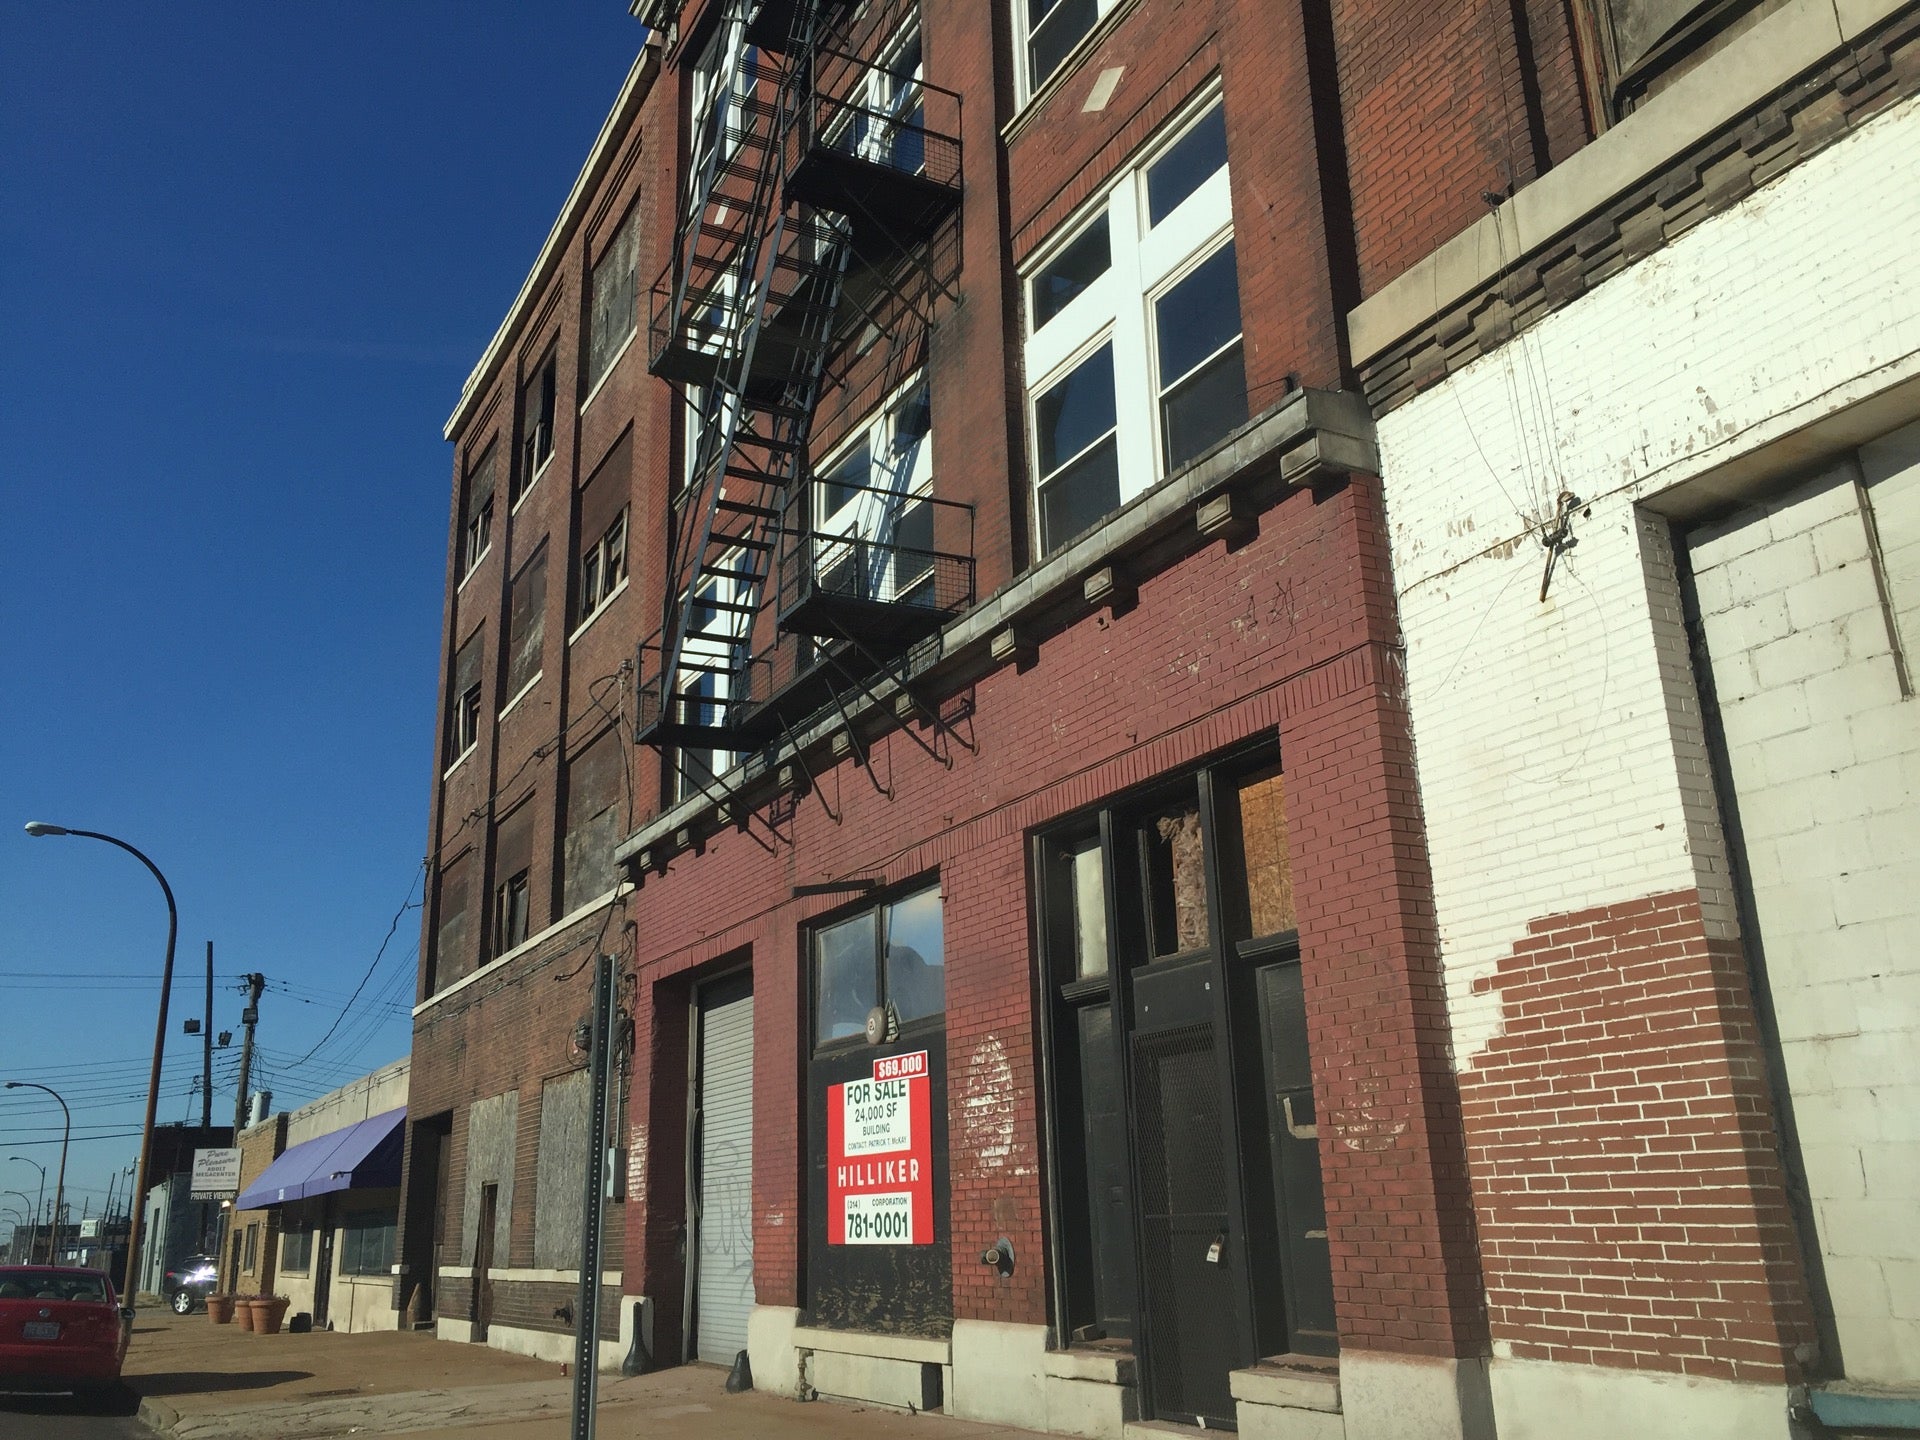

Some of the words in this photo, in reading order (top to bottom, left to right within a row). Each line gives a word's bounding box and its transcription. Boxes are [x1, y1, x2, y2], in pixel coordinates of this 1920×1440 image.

[879, 1055, 922, 1077] $69,000
[847, 1085, 870, 1106] FOR
[875, 1079, 906, 1101] SALE
[855, 1105, 884, 1124] 24,000
[887, 1102, 897, 1118] SF
[862, 1123, 890, 1136] BUILDING
[869, 1138, 885, 1148] PATRICK
[207, 1150, 228, 1158] Pure
[198, 1157, 236, 1167] Pleasure
[838, 1158, 919, 1187] HILLIKER
[190, 1192, 212, 1200] PRIVATE
[213, 1191, 235, 1200] VIEWING
[847, 1198, 861, 1210] (314)
[872, 1196, 908, 1207] CORPORATION
[847, 1211, 908, 1239] 781-0001
